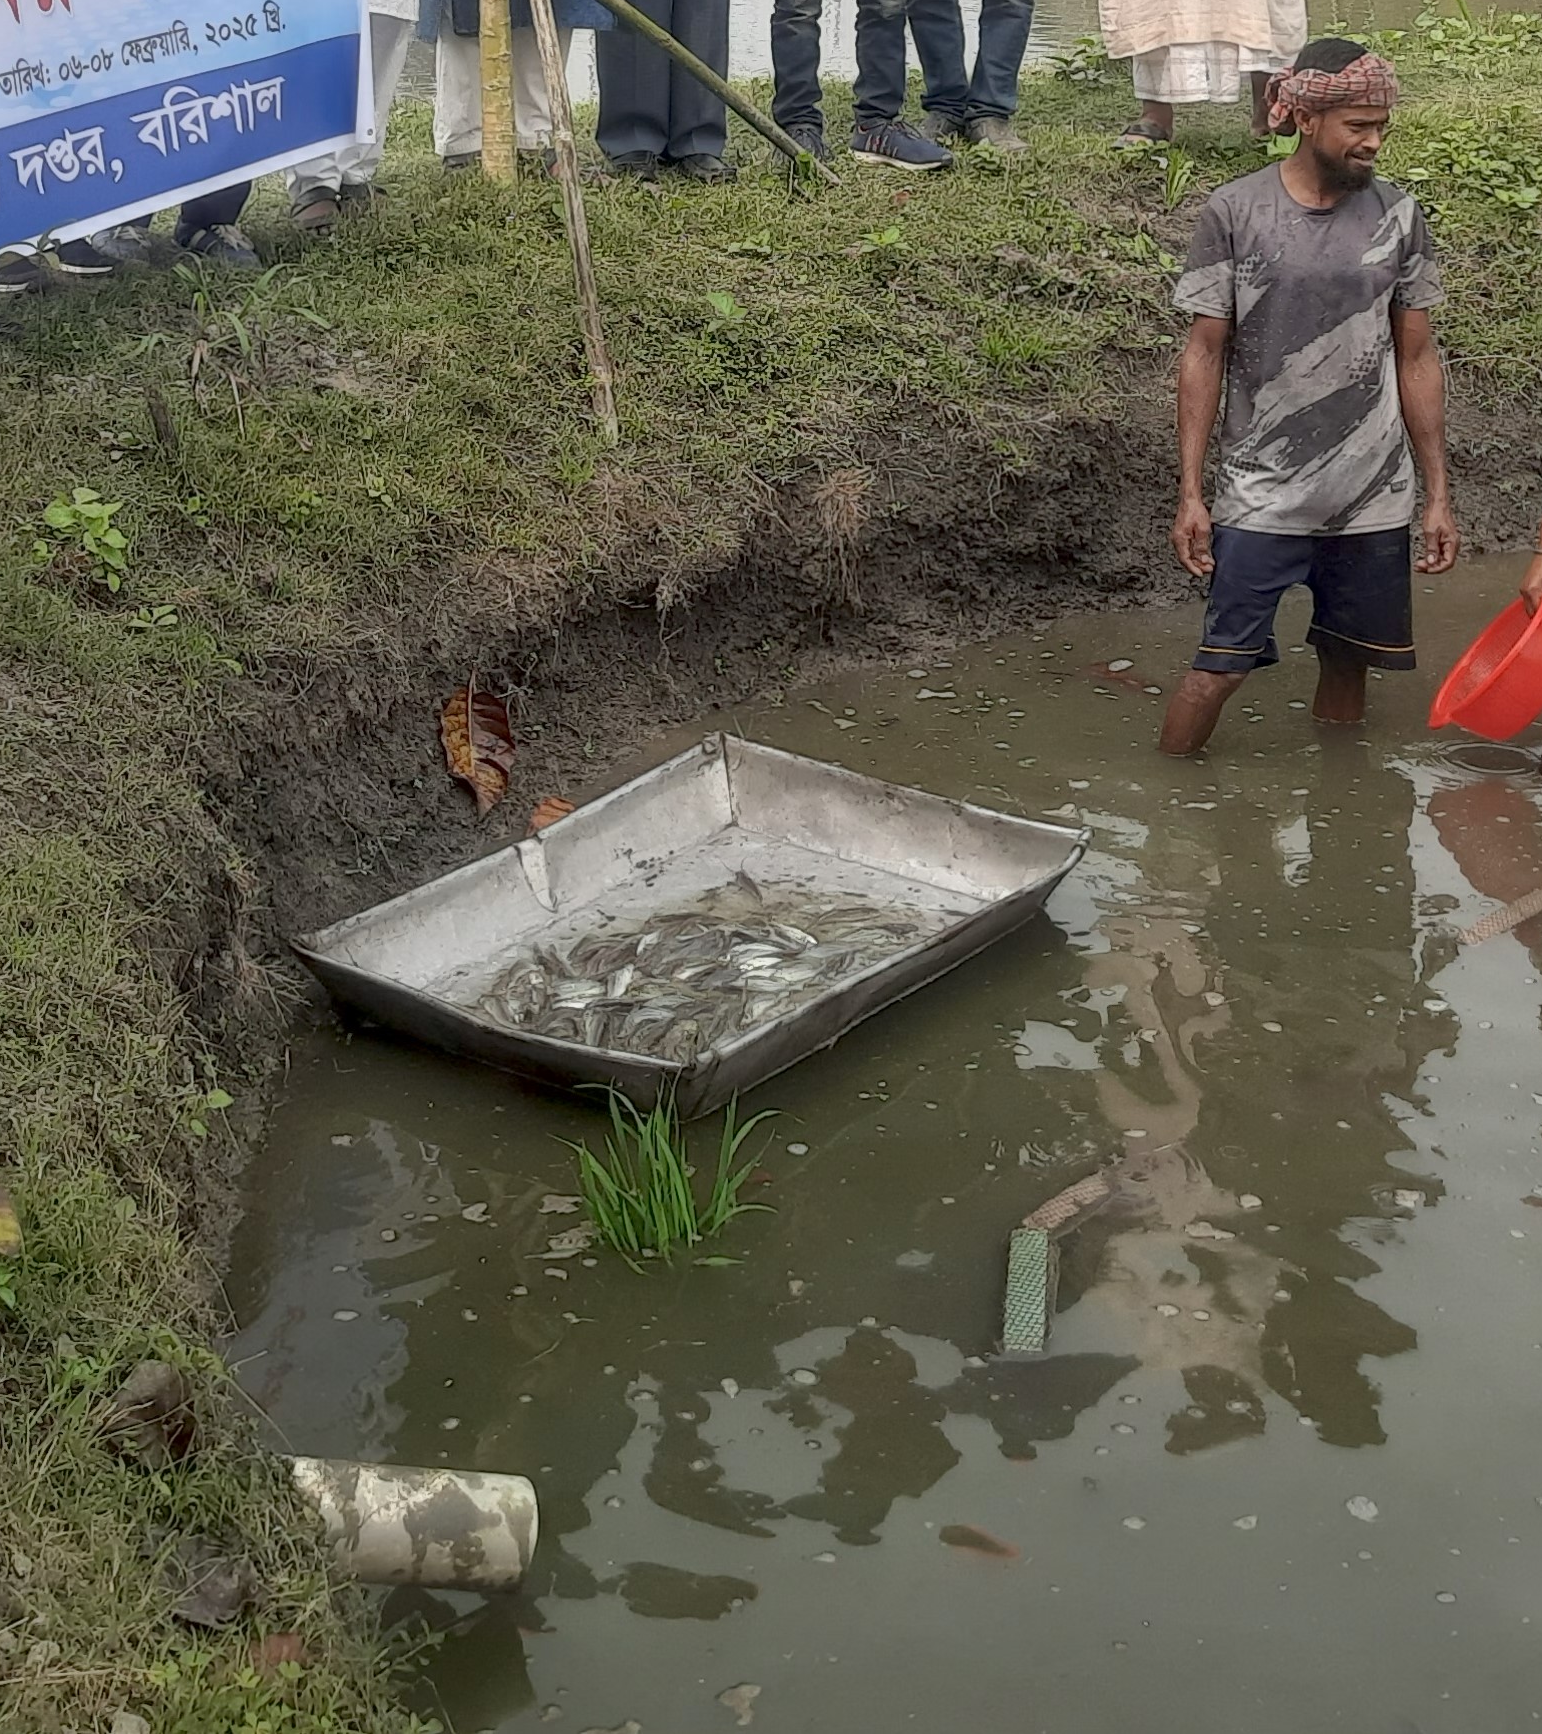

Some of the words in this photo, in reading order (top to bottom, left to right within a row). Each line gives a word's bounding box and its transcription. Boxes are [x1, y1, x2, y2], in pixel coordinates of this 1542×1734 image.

[58, 48, 115, 82] ০৬-০৮
[121, 19, 199, 67] ফেব্রুয়ারি,
[205, 13, 259, 48] ২০২৫
[9, 124, 126, 196] দপ্তর,
[130, 74, 287, 158] বরিশাল
